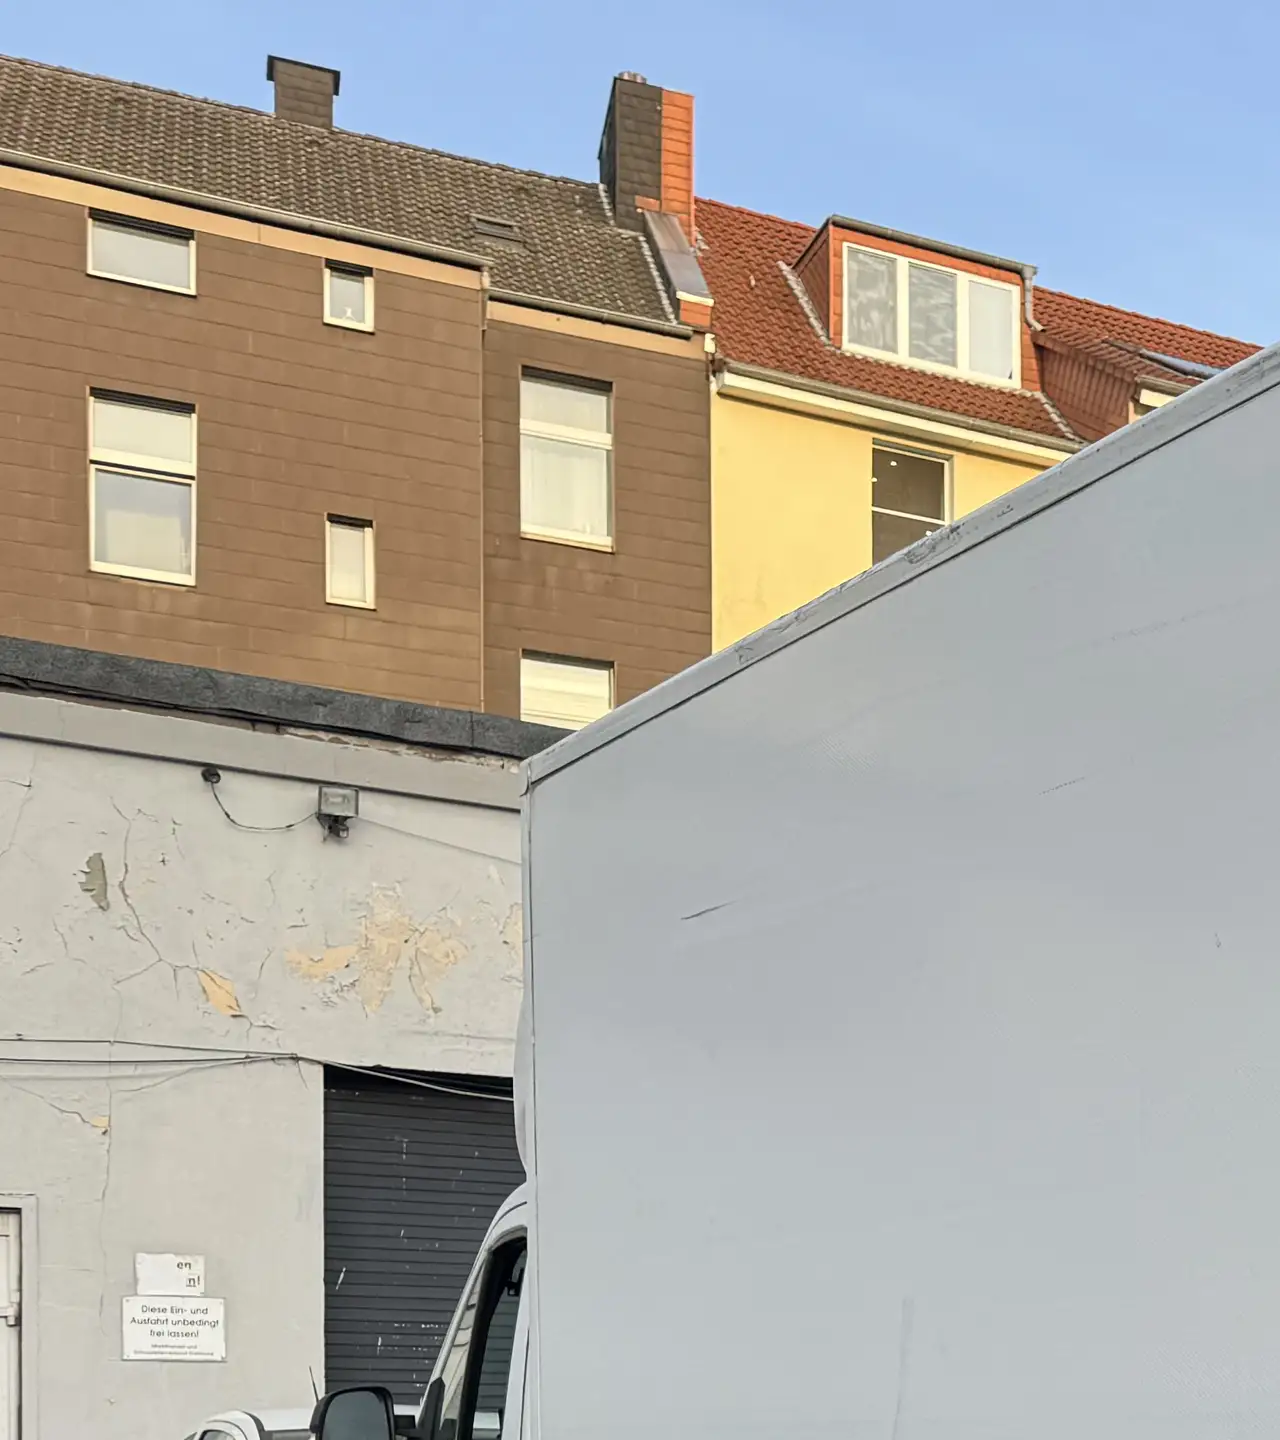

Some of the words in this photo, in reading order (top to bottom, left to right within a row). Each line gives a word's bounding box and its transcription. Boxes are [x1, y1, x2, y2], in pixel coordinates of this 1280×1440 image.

[141, 1304, 167, 1314] Diese
[170, 1305, 188, 1314] Ein-
[190, 1307, 209, 1315] und
[130, 1316, 169, 1326] Ausfahrt
[171, 1318, 219, 1328] unbedingt
[149, 1329, 165, 1337] frei
[167, 1329, 199, 1338] lassen!
